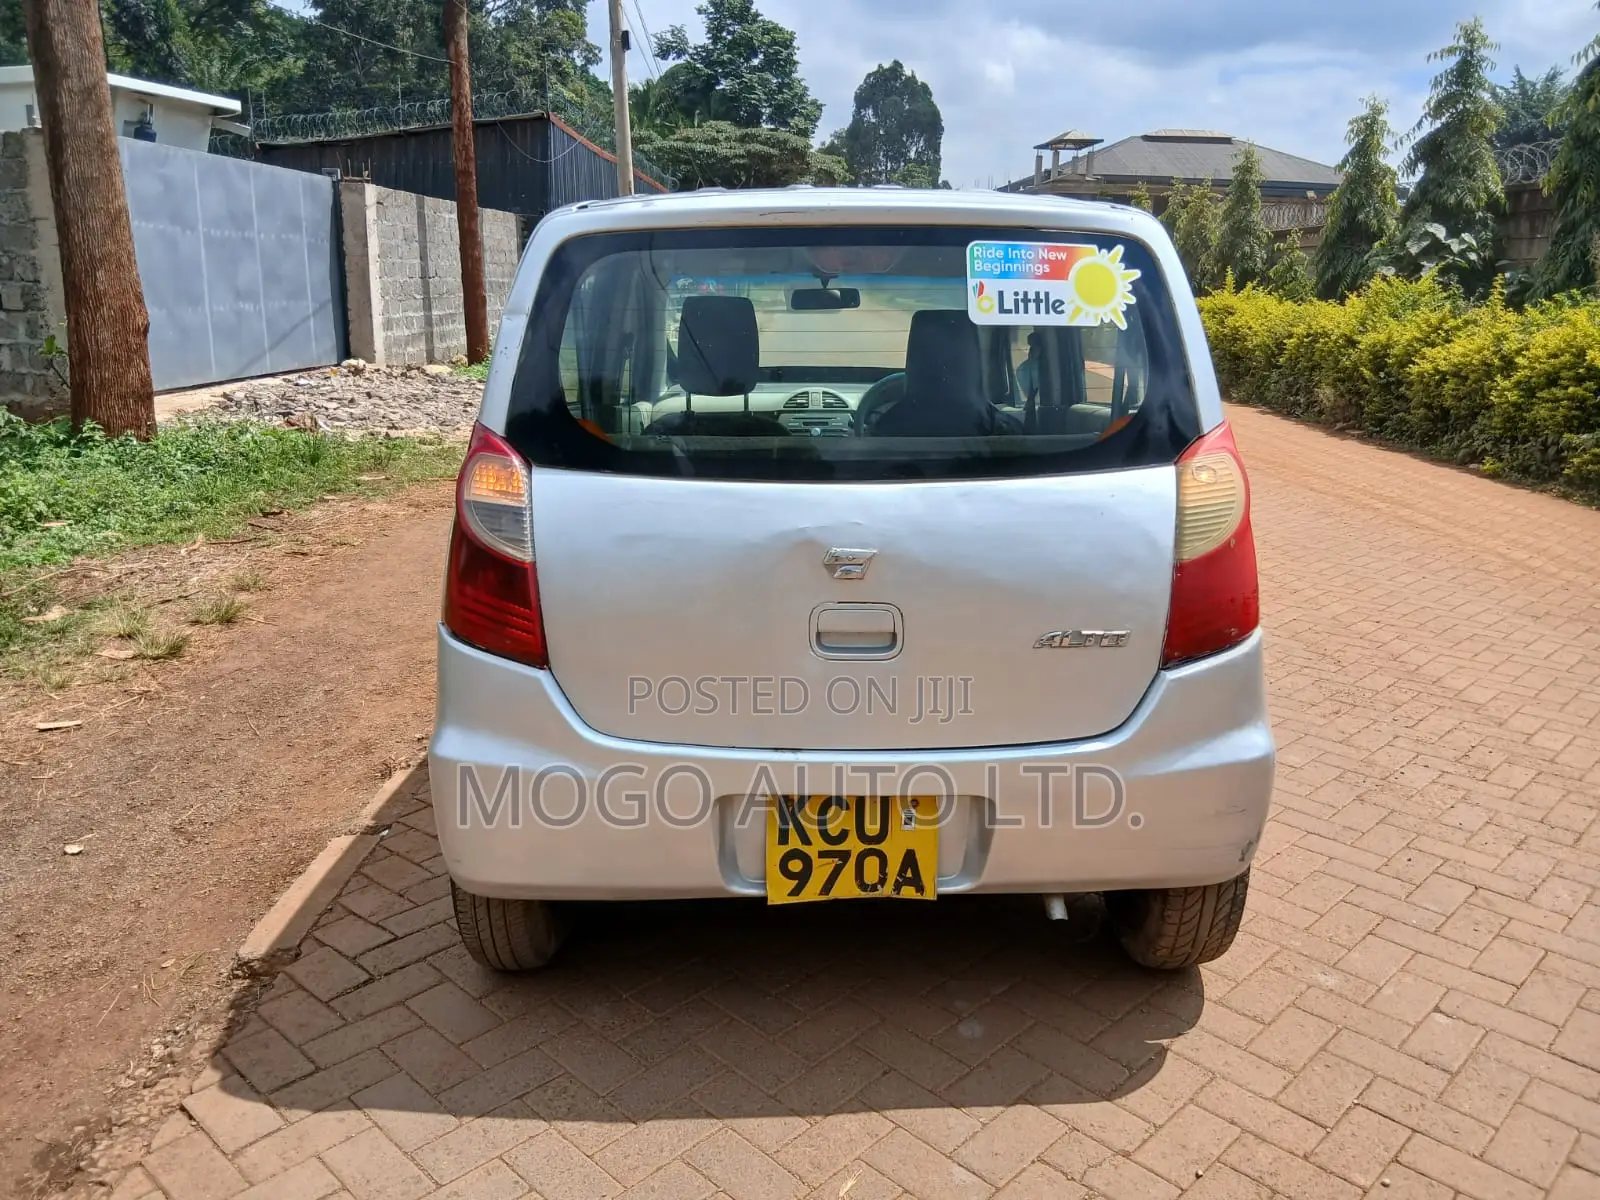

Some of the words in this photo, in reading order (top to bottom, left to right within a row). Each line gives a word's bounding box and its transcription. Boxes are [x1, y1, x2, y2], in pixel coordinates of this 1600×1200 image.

[973, 246, 1004, 259] Ride
[1008, 247, 1035, 260] Into
[1038, 249, 1068, 261] New
[974, 260, 1051, 275] Beginnings
[997, 290, 1066, 315] Little
[777, 795, 892, 846] KCU
[778, 847, 926, 897] 970A
